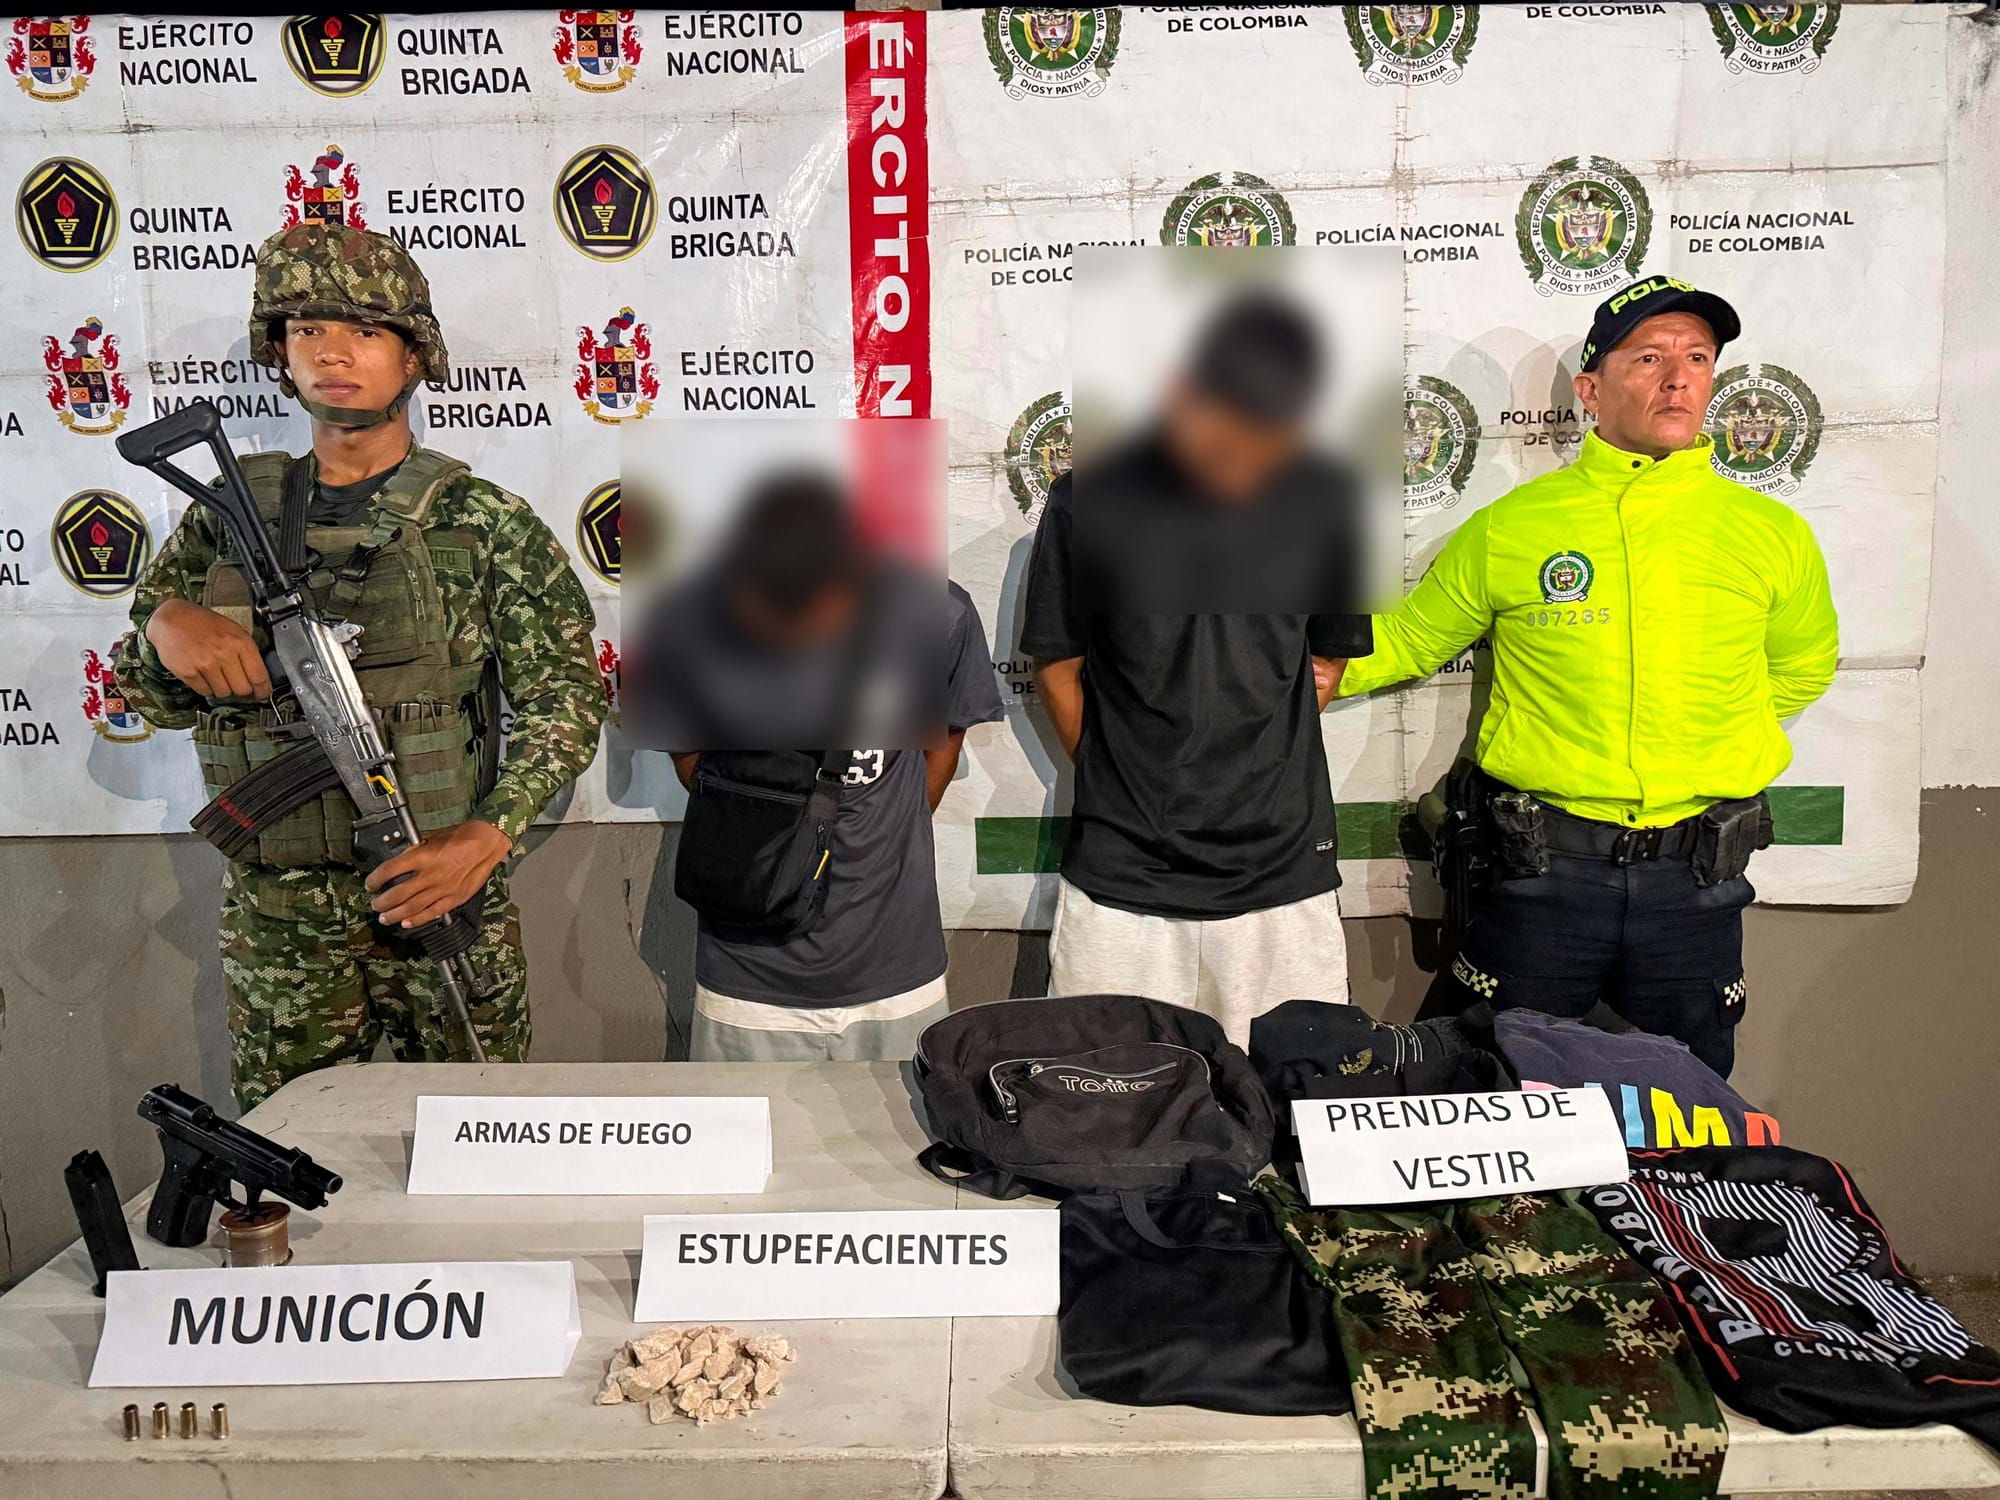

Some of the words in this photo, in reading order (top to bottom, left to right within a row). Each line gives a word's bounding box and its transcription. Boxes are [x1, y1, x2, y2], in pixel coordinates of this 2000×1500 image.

[664, 10, 803, 40] EJÉRCITO
[1168, 19, 1193, 33] DE
[1200, 15, 1308, 31] COLOMBIA
[1526, 7, 1552, 18] DE
[1558, 4, 1666, 17] COLOMBIA
[118, 20, 254, 51] EJÉRCITO
[397, 28, 503, 57] QUINTA
[120, 58, 257, 86] NACIONAL
[667, 47, 805, 76] NACIONAL
[402, 67, 531, 96] BRIGADA
[387, 183, 525, 215] EJÉRCITO
[669, 193, 769, 223] QUINTA
[1604, 177, 1636, 232] COLOMBIA
[130, 207, 233, 236] QUINTA
[1316, 224, 1395, 245] POLICÍA
[1401, 222, 1504, 241] NACIONAL
[1670, 210, 1742, 231] POLICÍA
[1746, 211, 1854, 229] NACIONAL
[390, 224, 526, 250] NACIONAL
[671, 231, 796, 259] BRIGADA
[1689, 237, 1713, 254] DE
[1718, 235, 1825, 253] COLOMBIA
[133, 243, 259, 271] BRIGADA
[964, 242, 1042, 264] POLICÍA
[991, 271, 1016, 286] DE
[681, 345, 815, 376] EJÉRCITO
[425, 366, 524, 393] QUINTA
[1748, 380, 1763, 388] DE
[684, 385, 816, 411] NACIONAL
[1406, 391, 1421, 399] DE
[429, 402, 551, 429] BRIGADA
[1500, 406, 1577, 425] POLICÍA
[1524, 432, 1549, 446] DE
[1412, 459, 1458, 494] NACIONAL
[1750, 449, 1799, 481] NACIONAL
[1411, 490, 1447, 508] PATRIA
[1326, 1094, 1512, 1133] PRENDAS
[1522, 1090, 1577, 1119] DE
[455, 1121, 550, 1144] ARMAS
[559, 1122, 592, 1144] DE
[601, 1122, 692, 1145] FUEGO
[1393, 1150, 1535, 1191] VESTIR
[678, 1233, 1008, 1266] ESTUPEFACIENTES
[168, 1280, 485, 1345] MUNICIÓN
